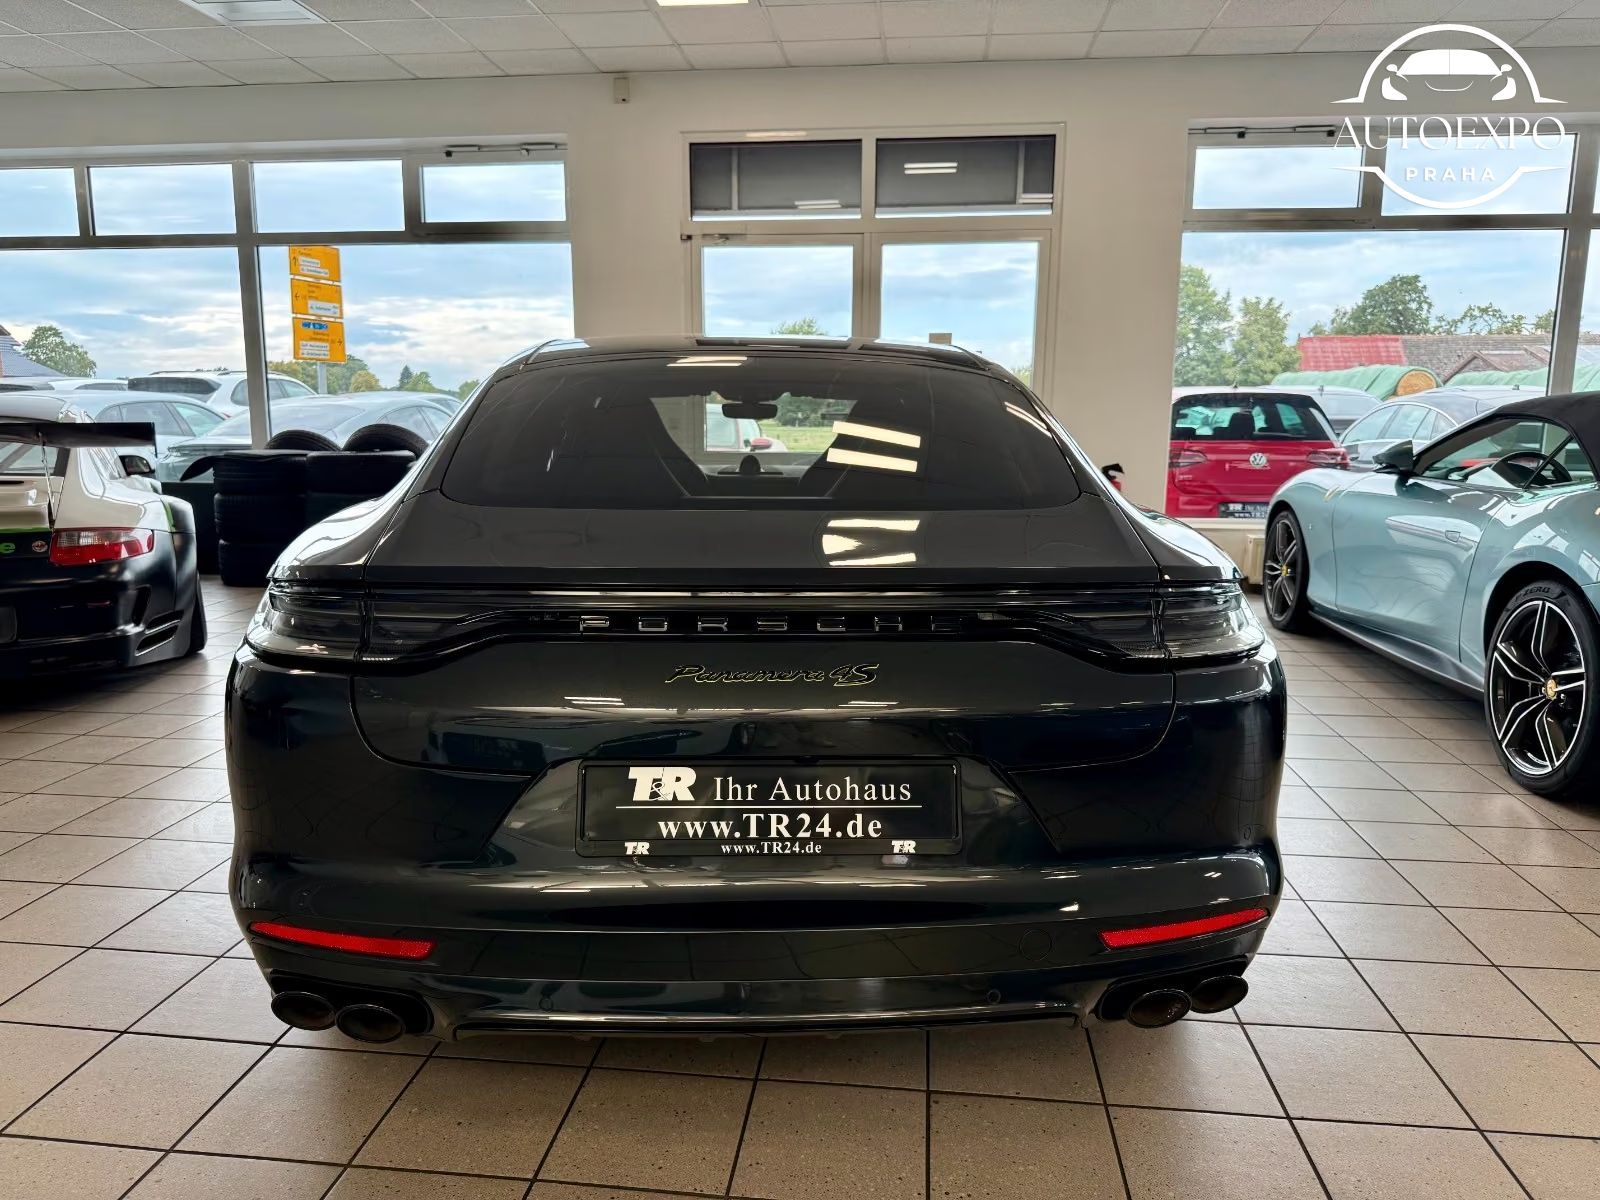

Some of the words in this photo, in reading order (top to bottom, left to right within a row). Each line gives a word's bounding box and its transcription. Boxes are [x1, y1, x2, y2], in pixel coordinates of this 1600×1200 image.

[579, 615, 962, 632] PORSCHE
[664, 664, 825, 684] Panamera
[829, 663, 880, 687] 4S
[628, 767, 697, 801] T&R
[714, 776, 757, 801] Ihr
[769, 776, 911, 801] Autohaus
[658, 813, 882, 838] www.TR24.de
[721, 842, 822, 854] www.TR24.de
